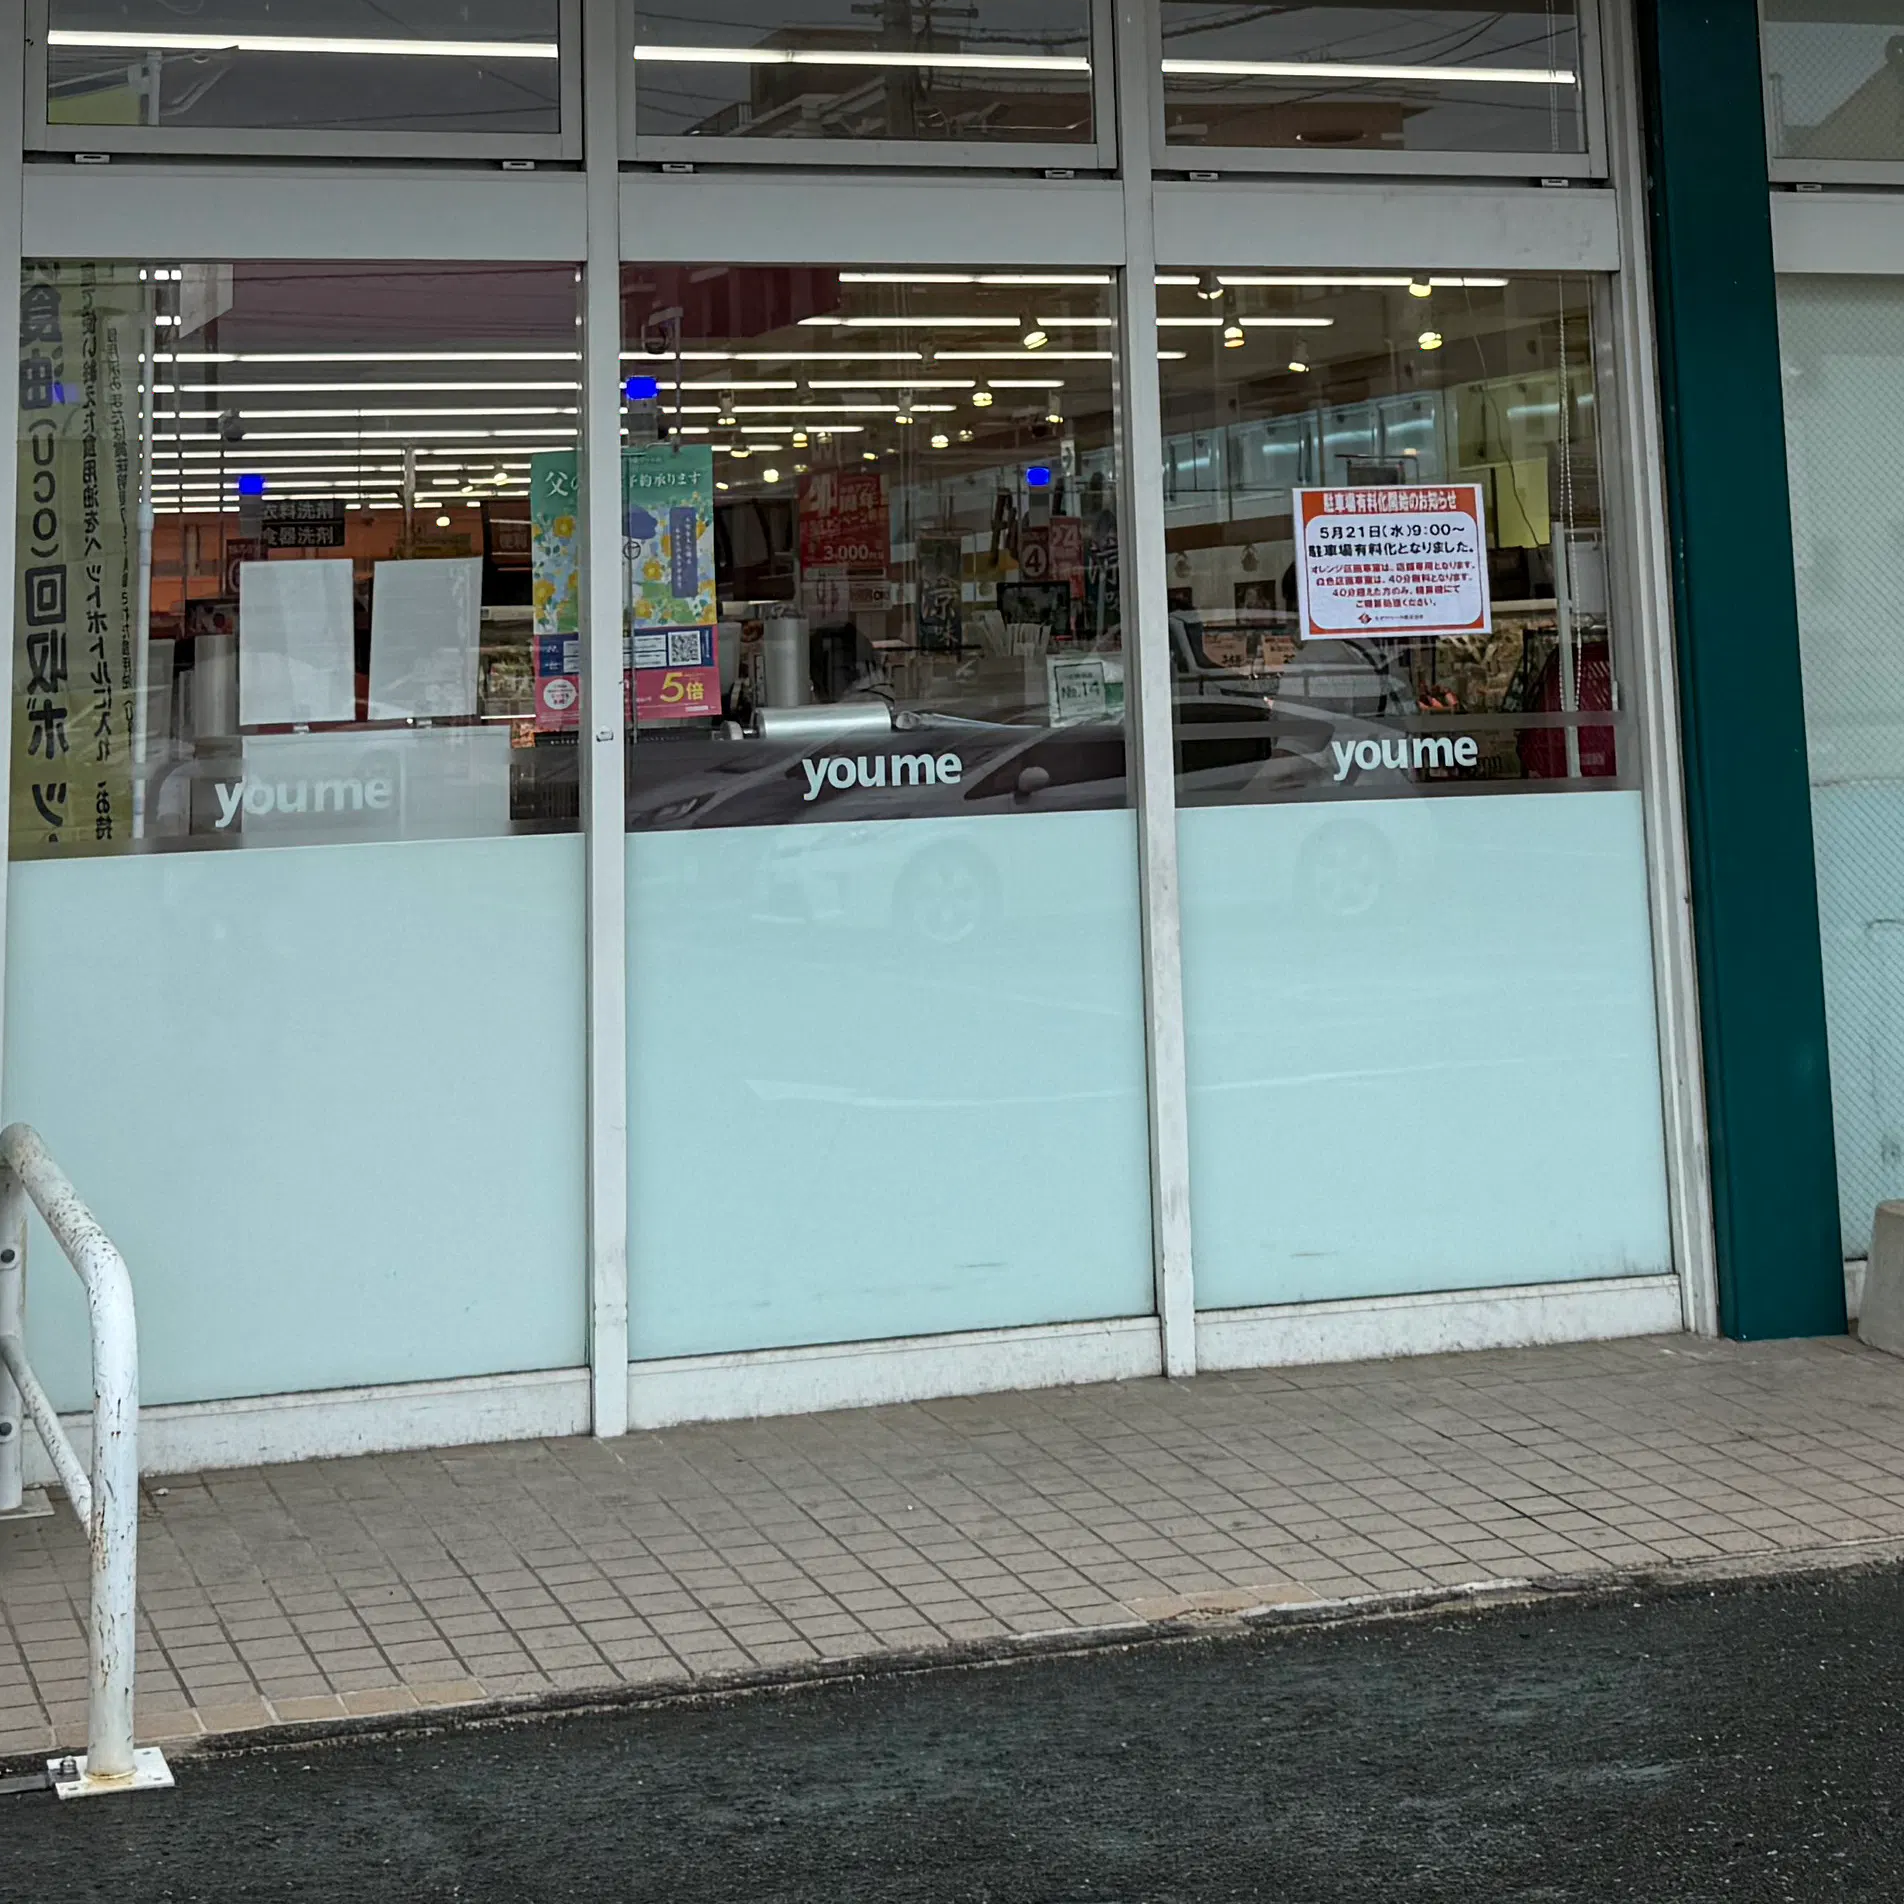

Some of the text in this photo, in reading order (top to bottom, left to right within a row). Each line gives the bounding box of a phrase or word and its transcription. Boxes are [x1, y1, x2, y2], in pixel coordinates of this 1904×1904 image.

[1308, 540, 1475, 559] 駐車場有料化となりました。
[659, 672, 705, 704] 5倍
[801, 750, 963, 800] youme
[1331, 734, 1479, 781] youme
[214, 773, 393, 828] youme
